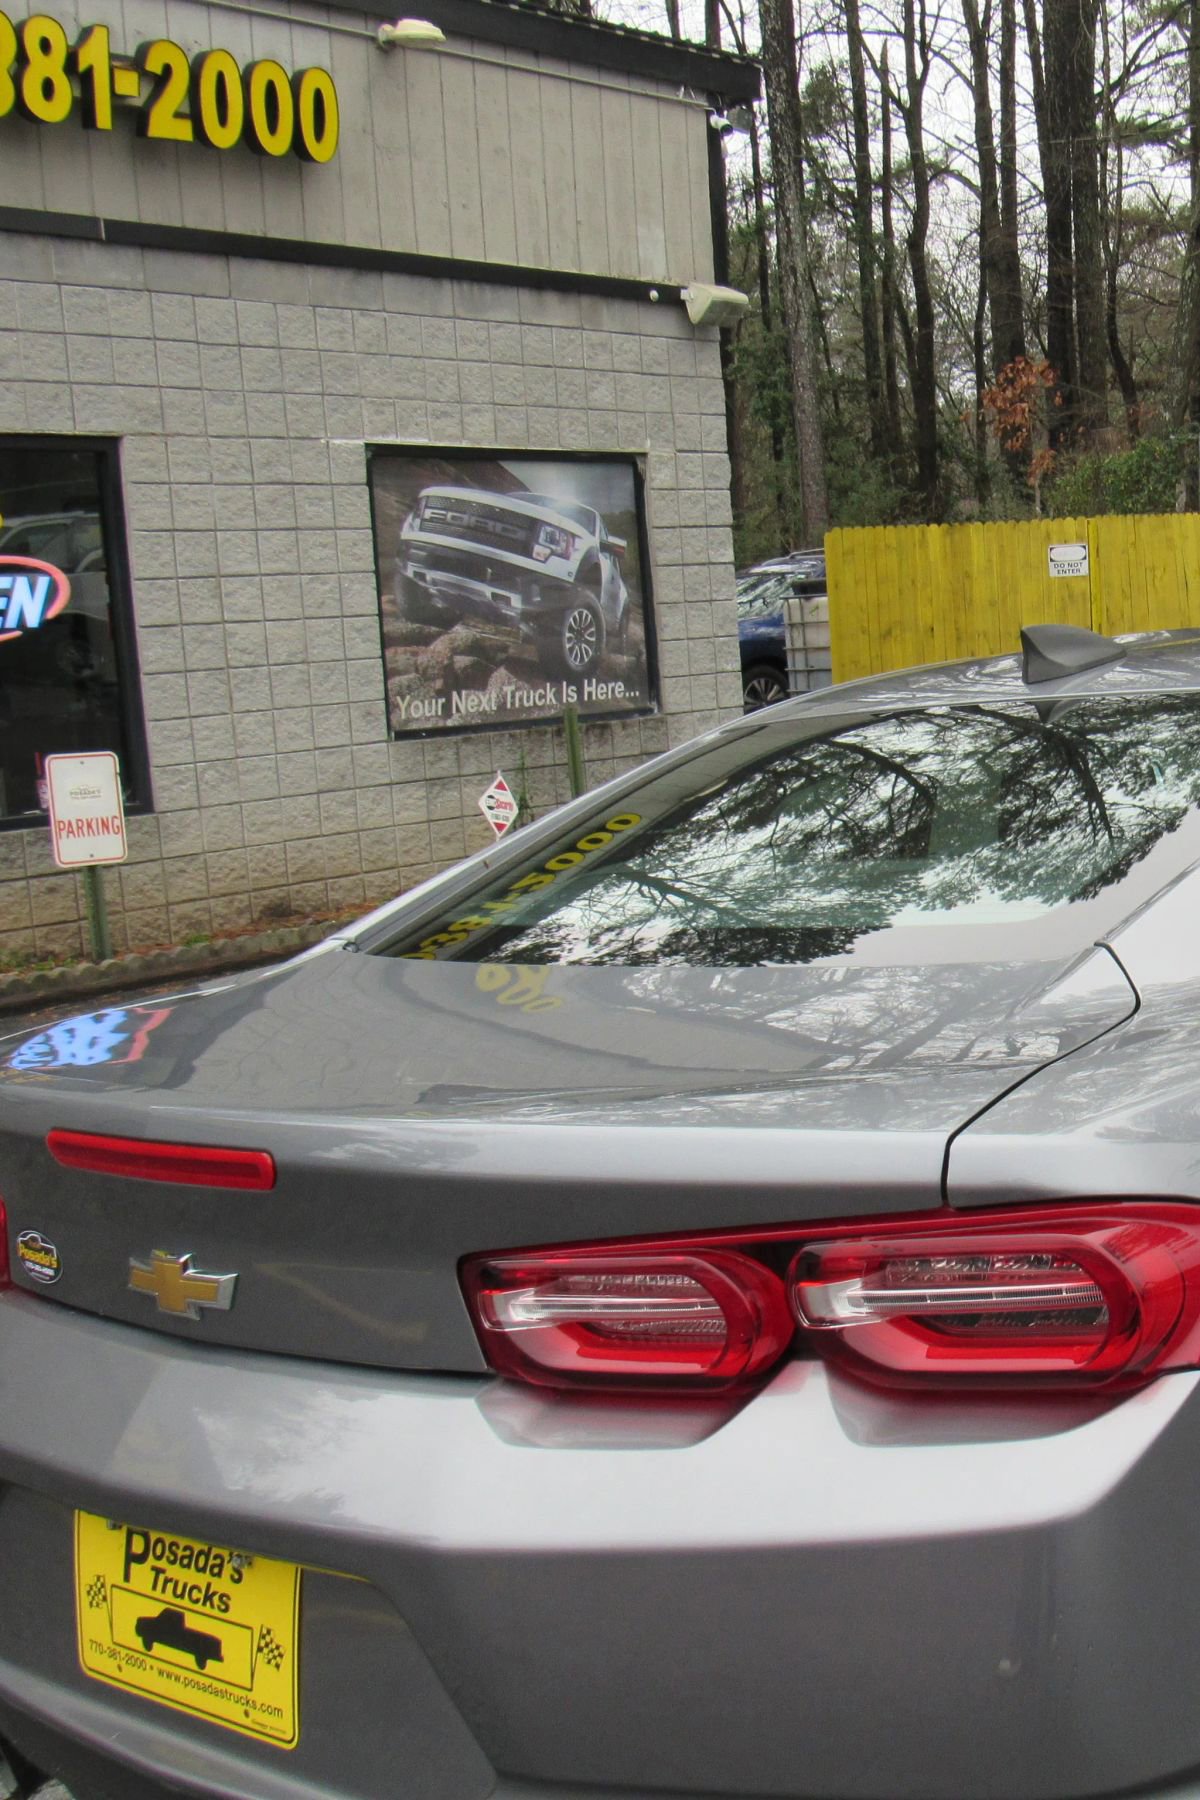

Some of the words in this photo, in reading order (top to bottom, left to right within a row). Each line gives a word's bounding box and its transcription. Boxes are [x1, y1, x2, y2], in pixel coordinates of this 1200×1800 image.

[1067, 561, 1084, 569] NOT
[396, 695, 446, 720] Your
[452, 690, 497, 715] Next
[503, 682, 557, 709] Truck
[562, 681, 577, 703] Is
[583, 678, 640, 701] Here...
[56, 815, 121, 840] PARKING
[123, 1527, 244, 1584] Posada's
[150, 1564, 232, 1614] Trucks
[89, 1638, 147, 1671] 770-381-2000
[156, 1667, 284, 1719] www.posadastrucks.com
